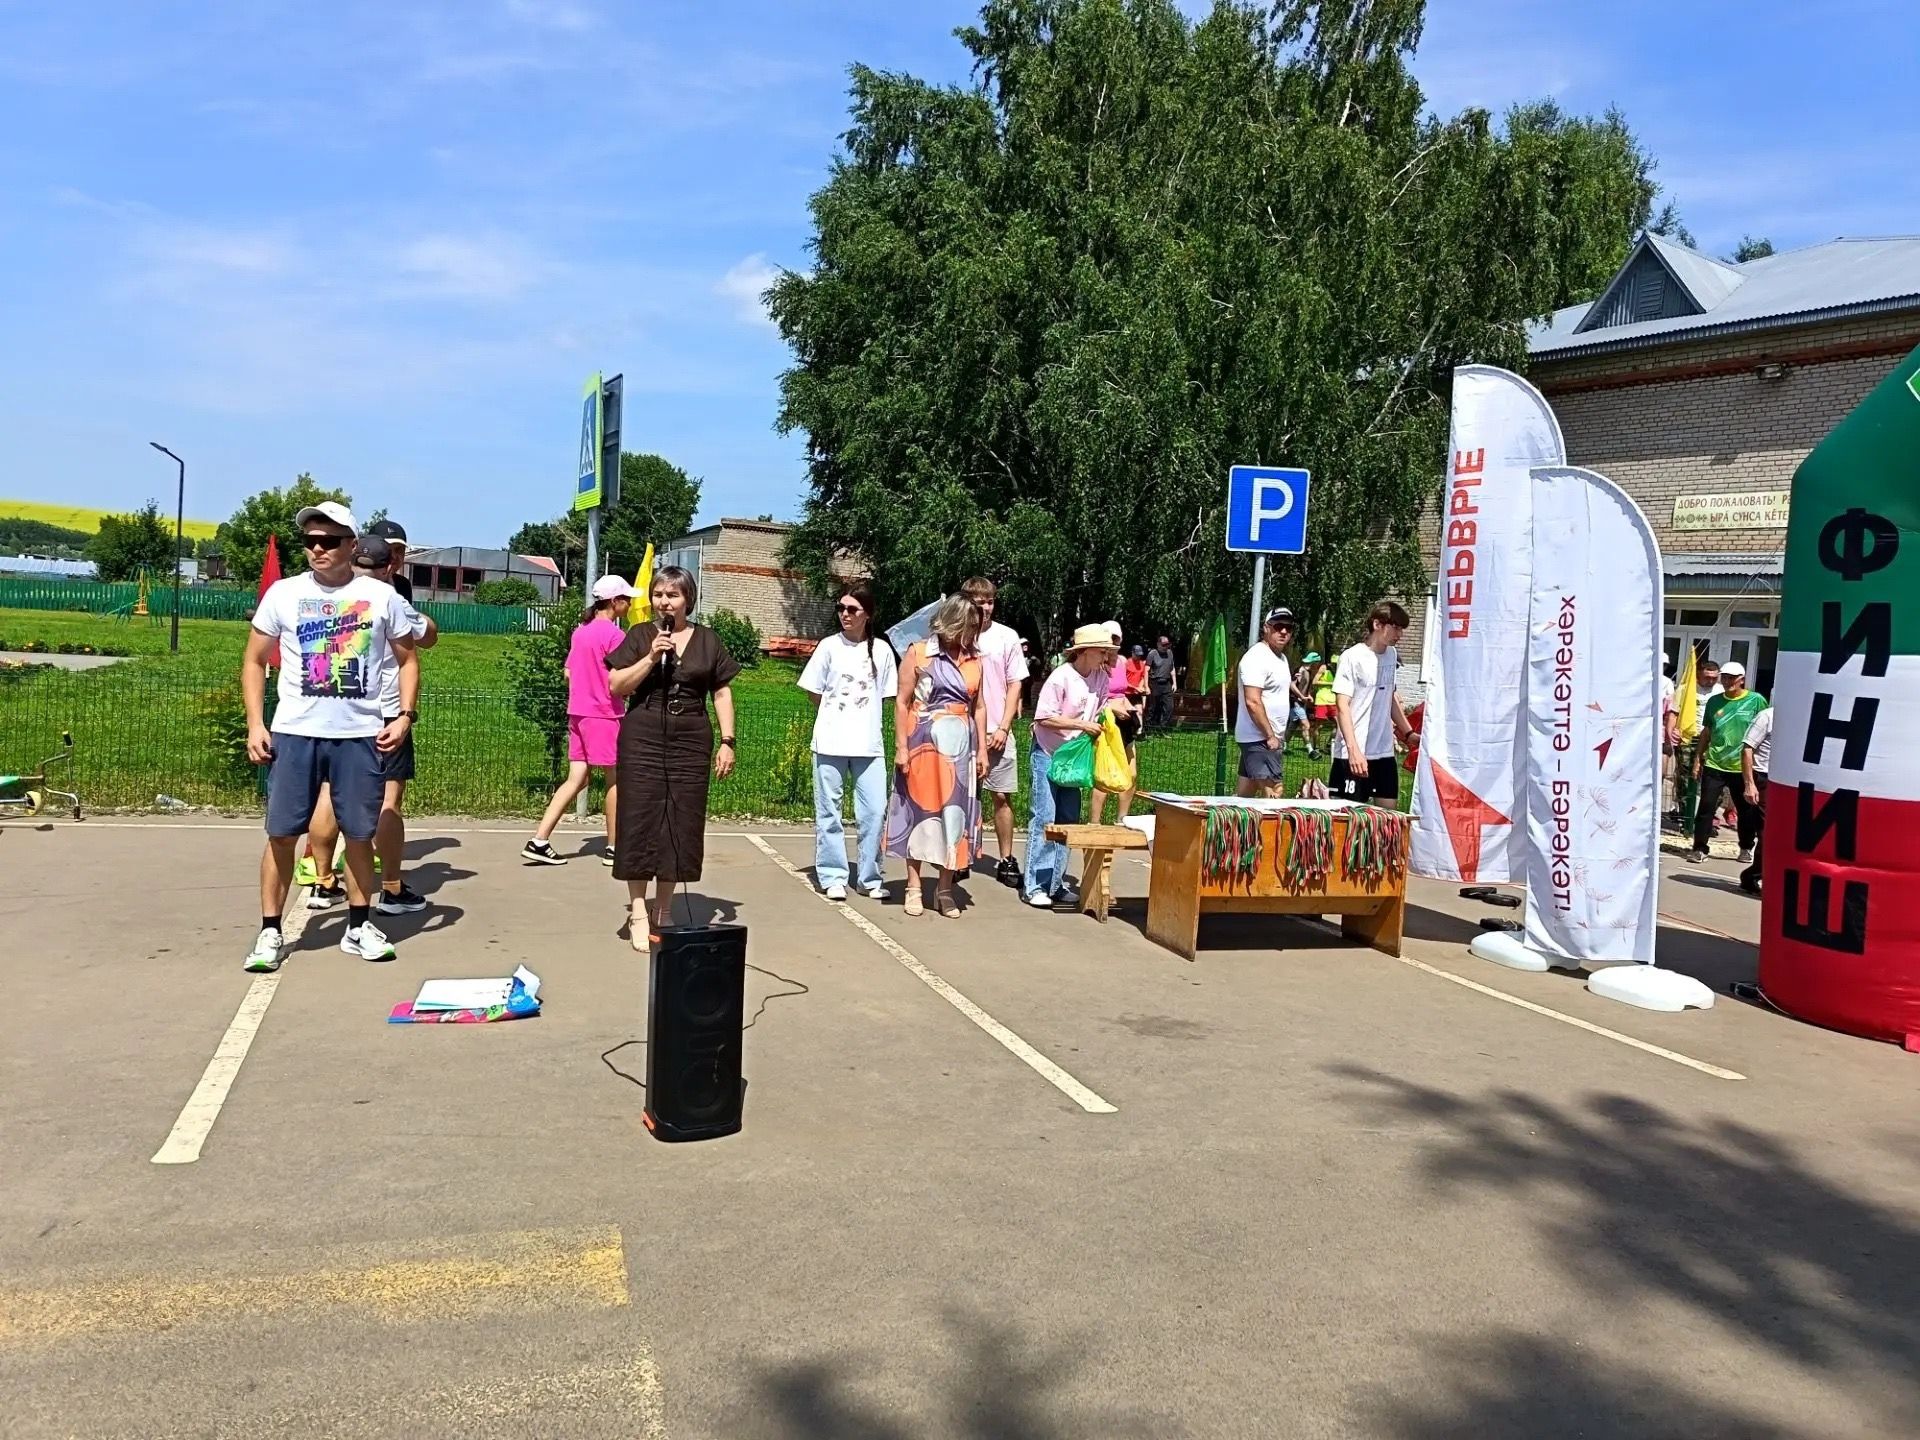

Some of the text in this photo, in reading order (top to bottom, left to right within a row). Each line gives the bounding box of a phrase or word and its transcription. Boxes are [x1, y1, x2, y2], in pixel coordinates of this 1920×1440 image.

[1250, 477, 1294, 541] P
[1678, 498, 1707, 509] ДОБРО
[1710, 495, 1775, 507] ПОЖАЛОВАТЬ!
[1782, 507, 1900, 955] ФИНИШ
[1344, 780, 1356, 794] 18
